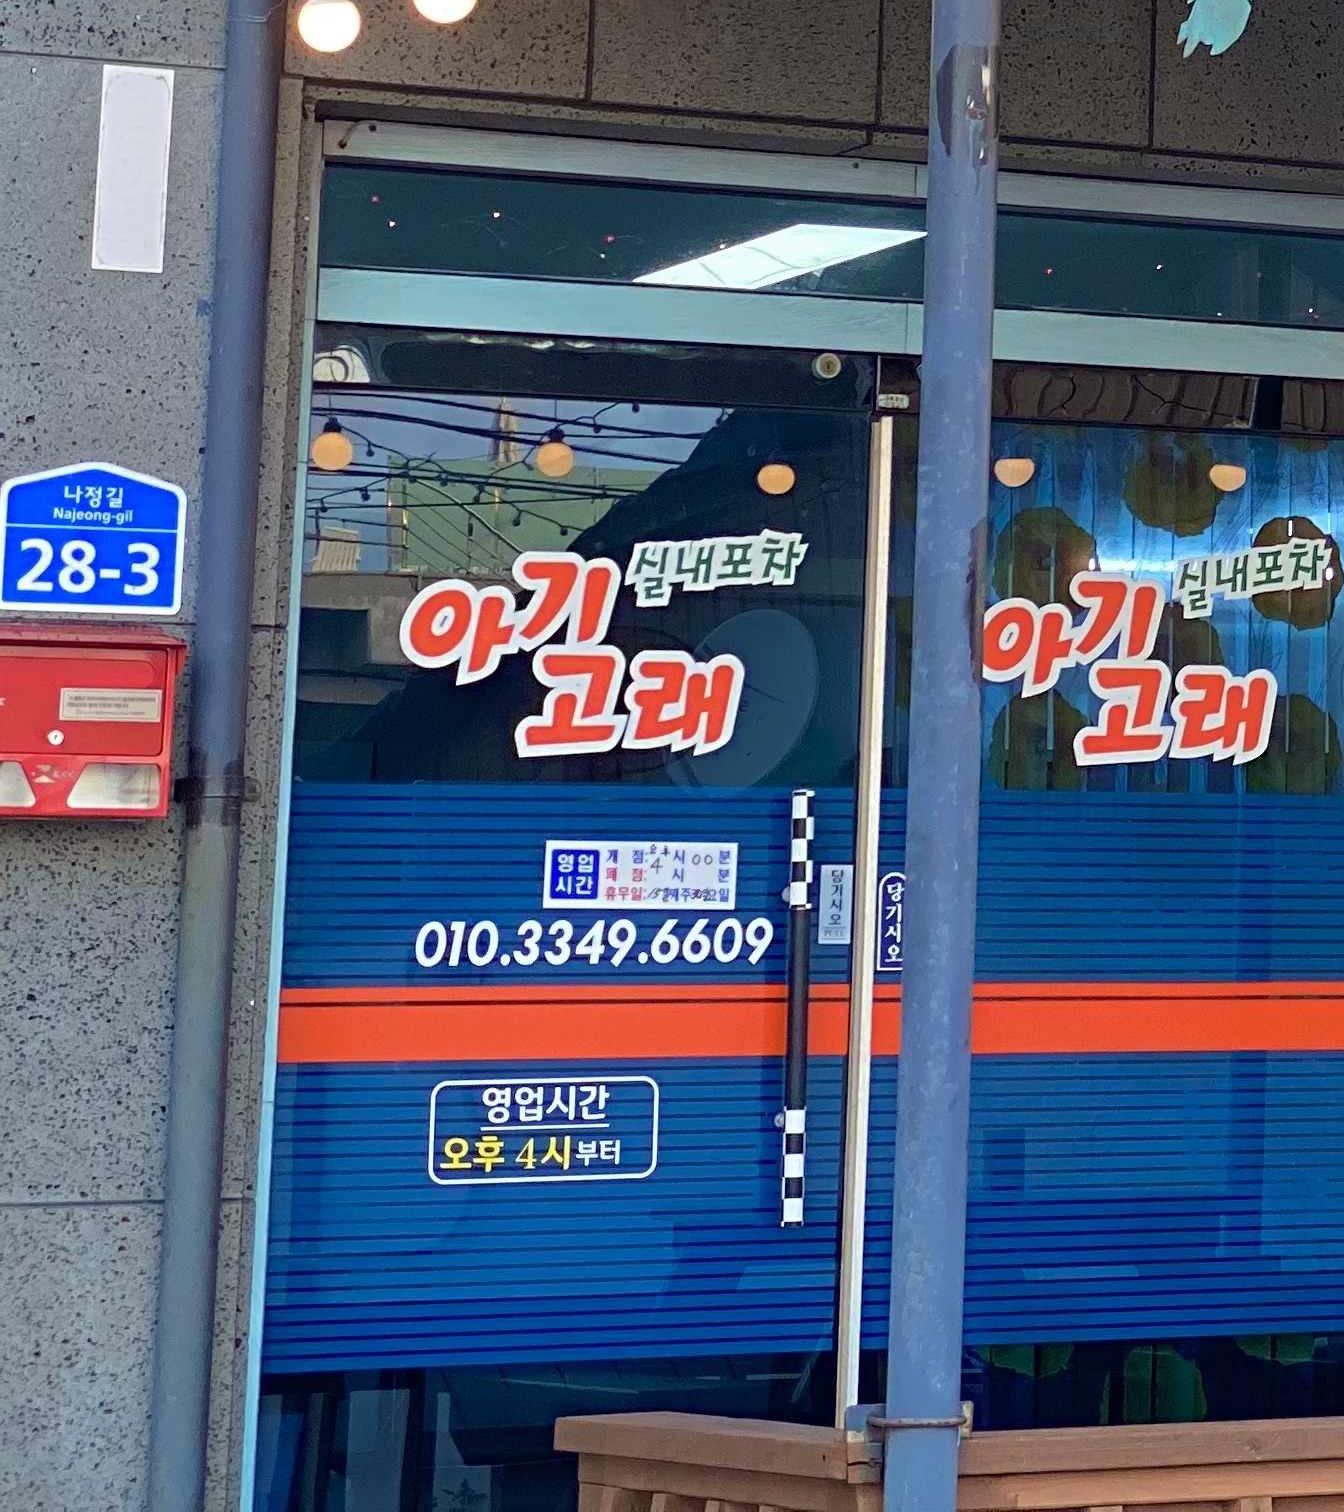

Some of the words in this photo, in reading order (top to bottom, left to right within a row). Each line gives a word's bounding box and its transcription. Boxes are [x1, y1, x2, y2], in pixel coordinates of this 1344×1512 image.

[52, 507, 134, 525] Najeong-gil
[63, 485, 125, 509] 나정길
[16, 538, 161, 597] 28-3
[633, 535, 802, 601] 실내포차
[1177, 541, 1328, 613] 실내포차
[408, 559, 614, 676] 아기
[983, 578, 1160, 688] 아기
[522, 653, 736, 748] 고래
[1081, 665, 1271, 756] 고래
[555, 875, 593, 895] 시간
[557, 853, 595, 873] 영업
[829, 869, 844, 925] 당기시오
[884, 881, 904, 963] 당기시오
[415, 918, 774, 968] 010.3349.6609
[481, 1085, 610, 1123] 영업시간
[440, 1135, 505, 1173] 오후
